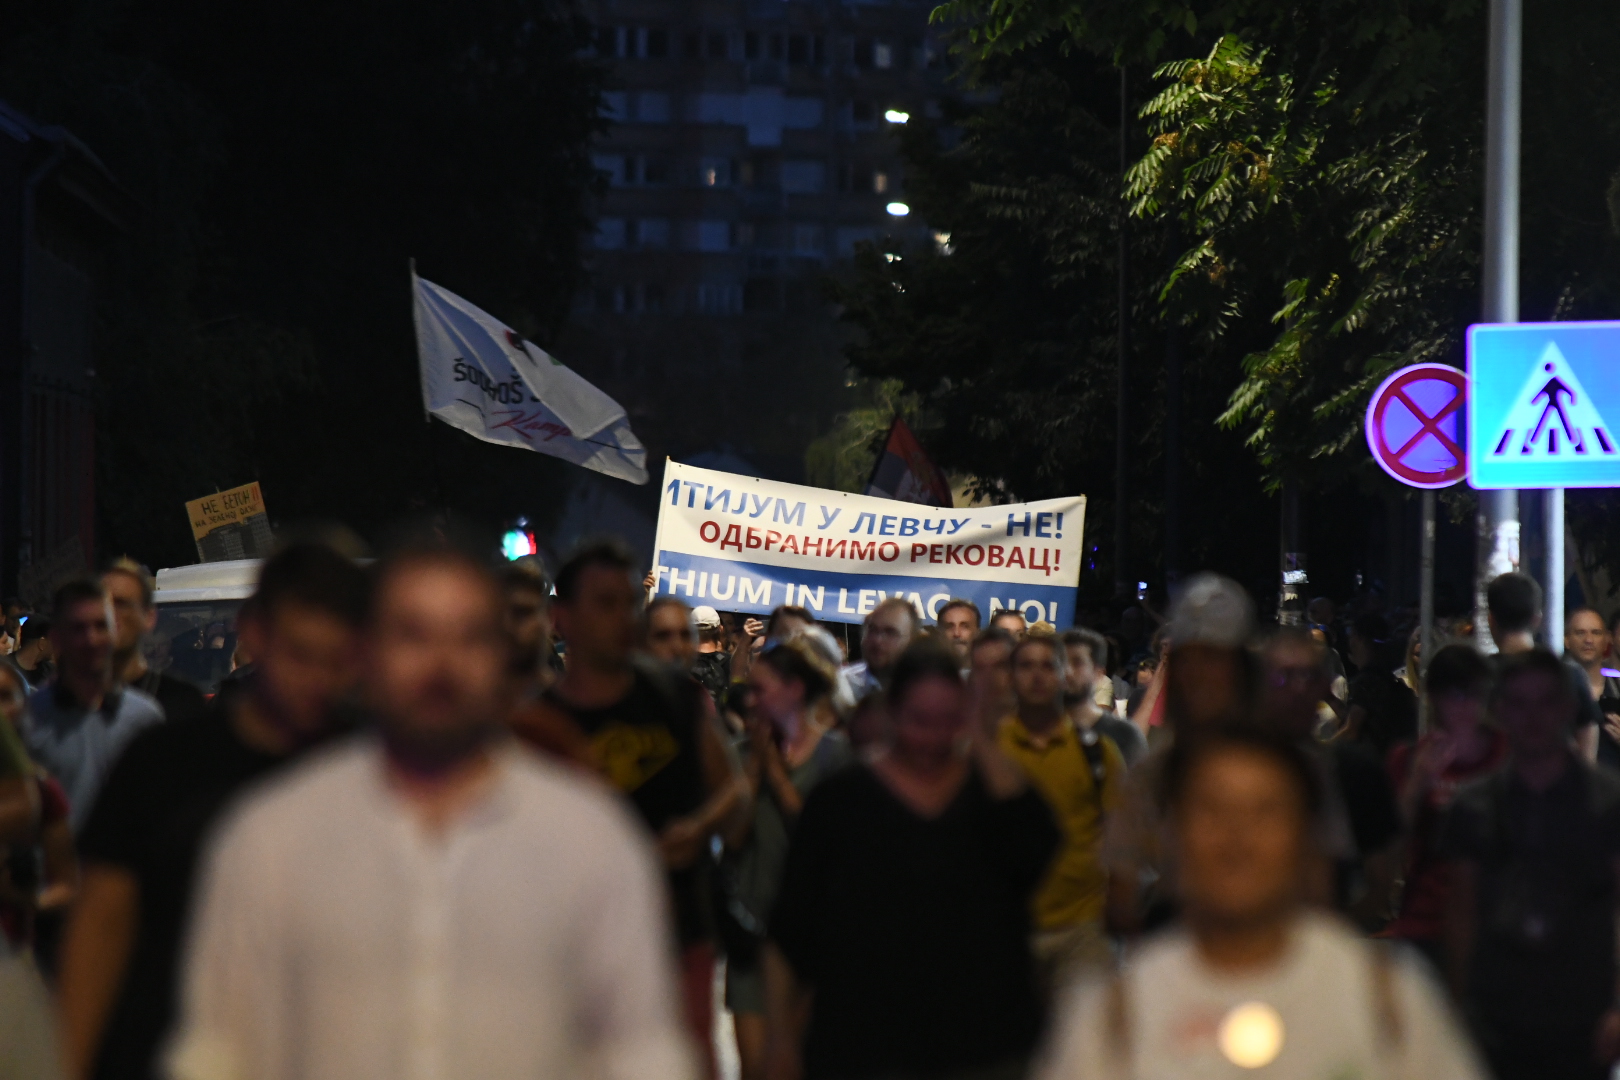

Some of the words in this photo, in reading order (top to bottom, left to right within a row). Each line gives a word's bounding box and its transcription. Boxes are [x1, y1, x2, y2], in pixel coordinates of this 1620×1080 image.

[201, 499, 220, 515] НЕ
[195, 520, 207, 528] НА
[817, 505, 842, 530] У
[849, 511, 972, 537] ЛЕВЧУ
[1006, 512, 1064, 539] НЕ!
[699, 520, 901, 562] ОДБРАНИМО
[910, 542, 1062, 576] РЕКОВАЦ!
[785, 583, 826, 611] IN
